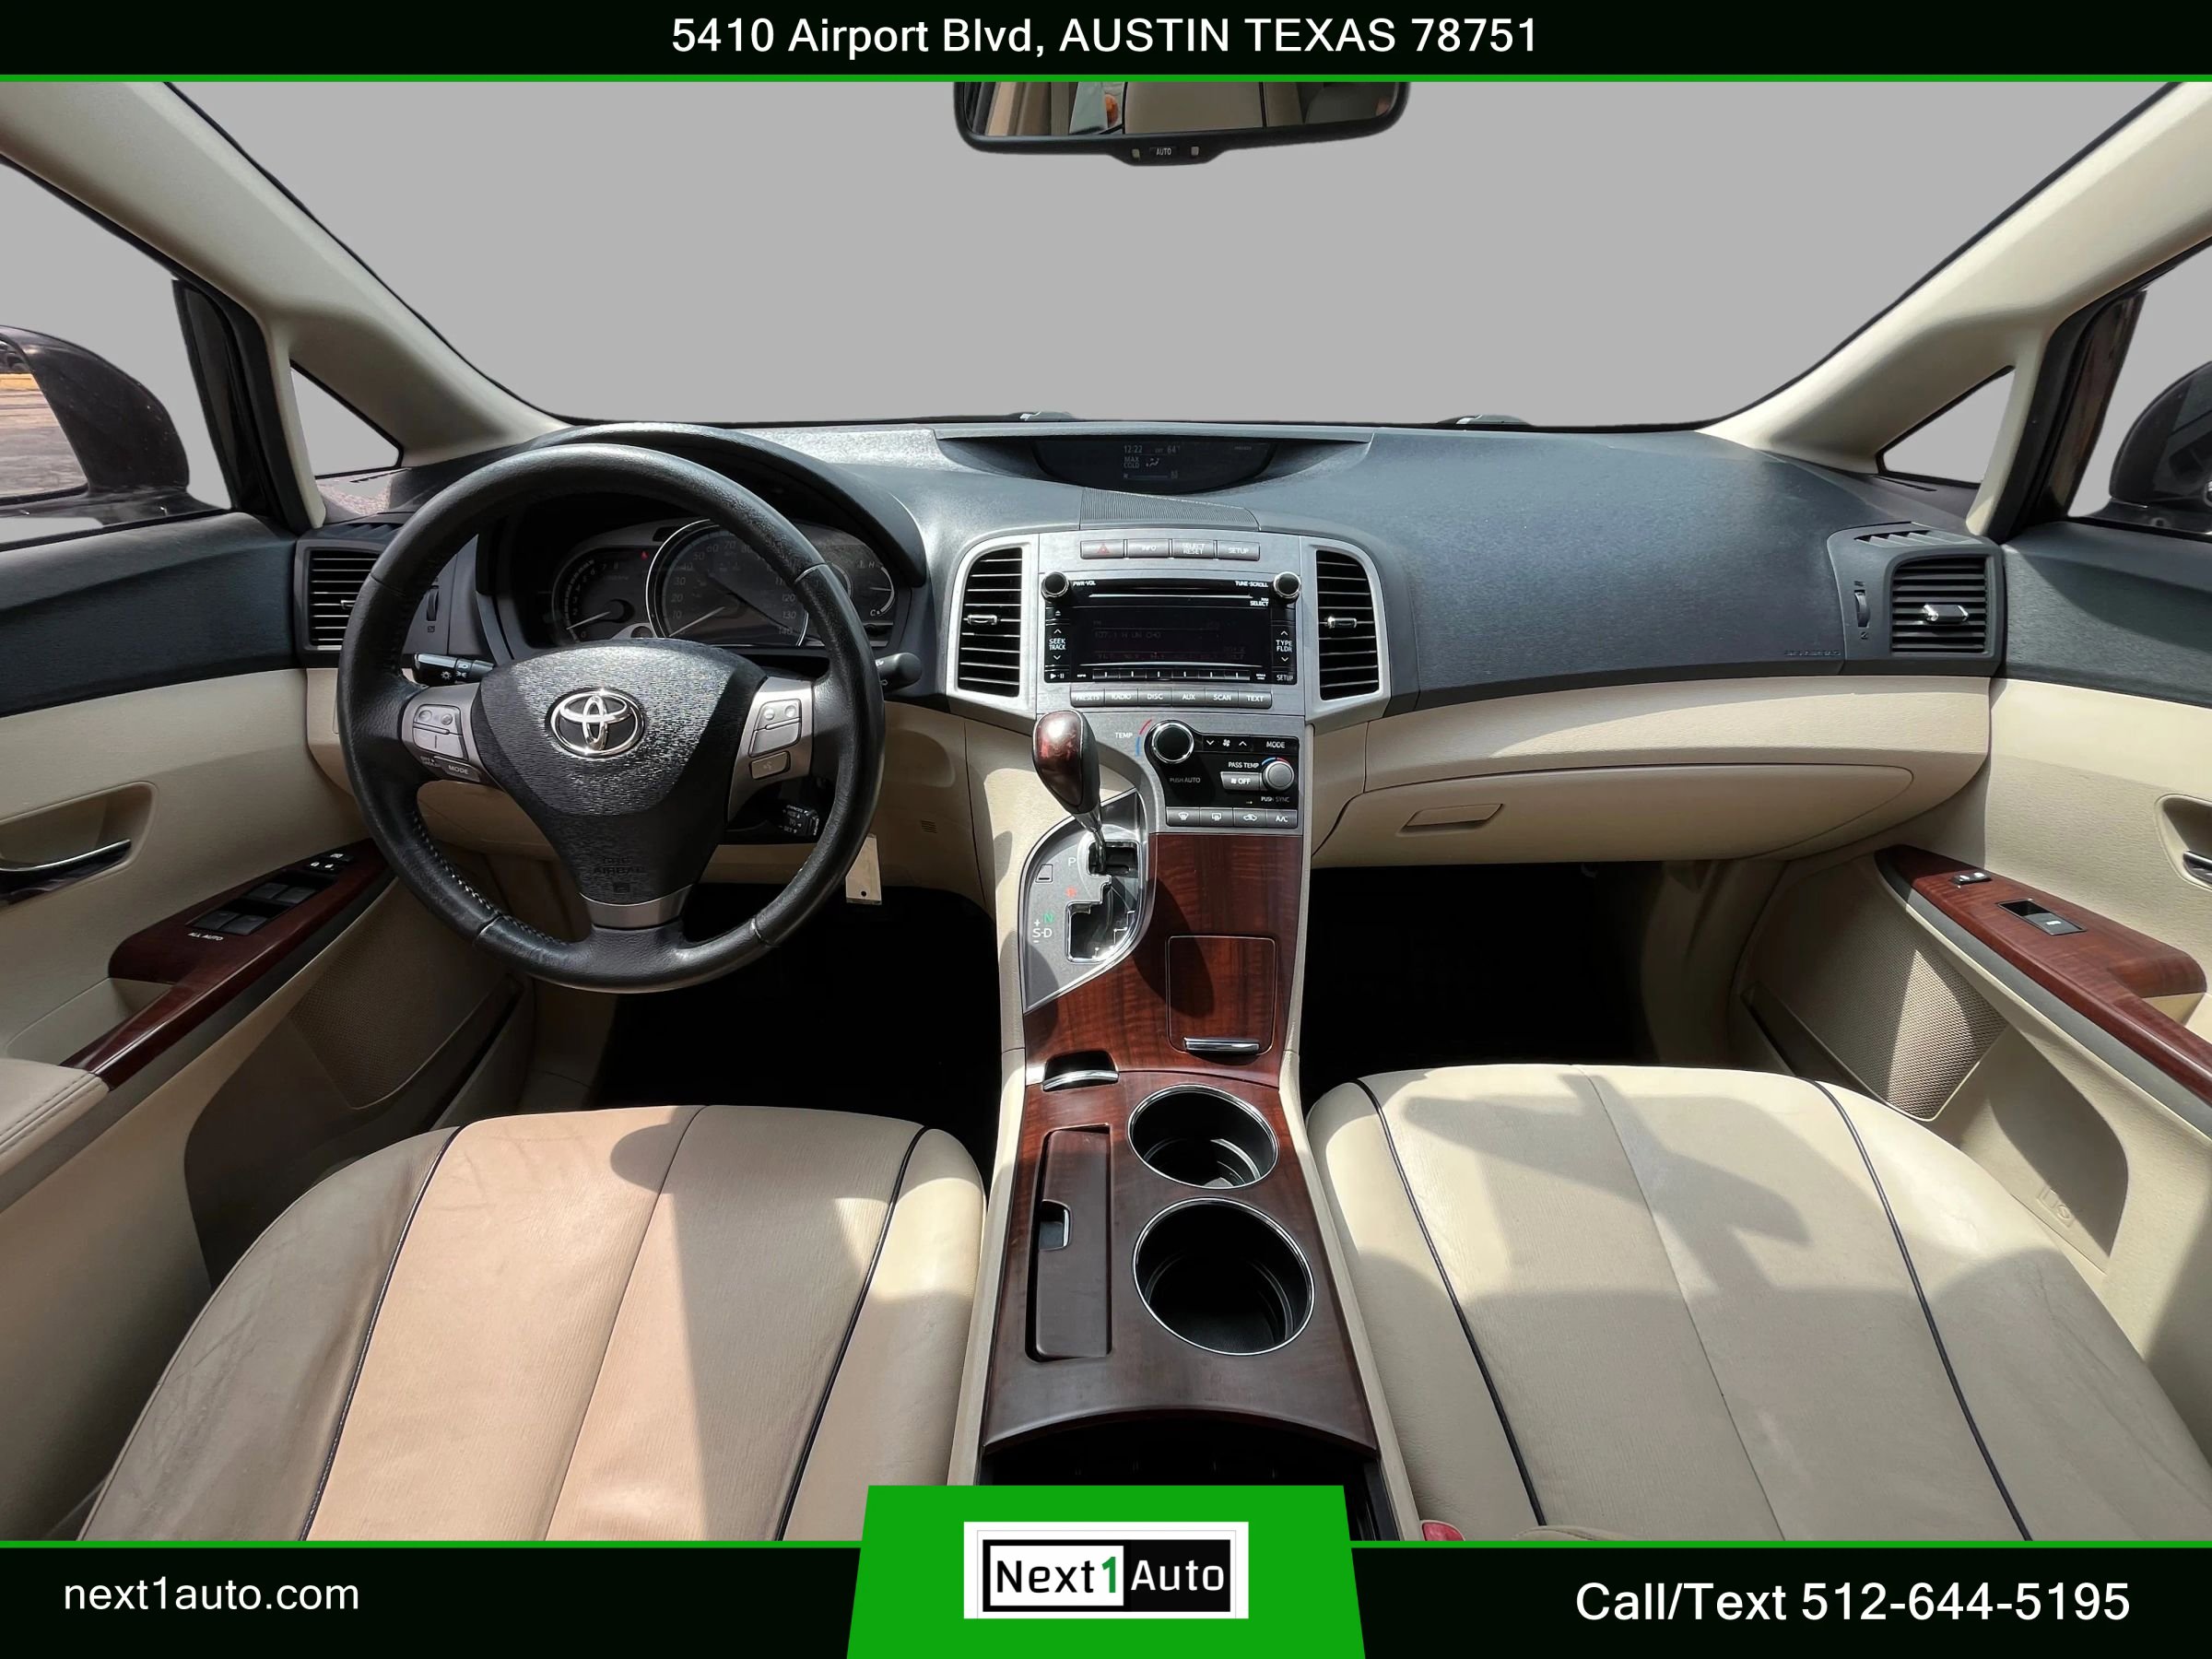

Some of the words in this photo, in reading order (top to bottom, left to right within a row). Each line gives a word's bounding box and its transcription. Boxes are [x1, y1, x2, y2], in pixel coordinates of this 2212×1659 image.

[1156, 147, 1172, 156] AUTO
[1228, 547, 1249, 555] SETUP
[1276, 674, 1294, 682] SETUP
[1265, 740, 1286, 748] MODE
[448, 764, 470, 775] MODE
[1237, 777, 1252, 785] OFF
[1275, 815, 1288, 823] A/C
[1067, 857, 1077, 866] P
